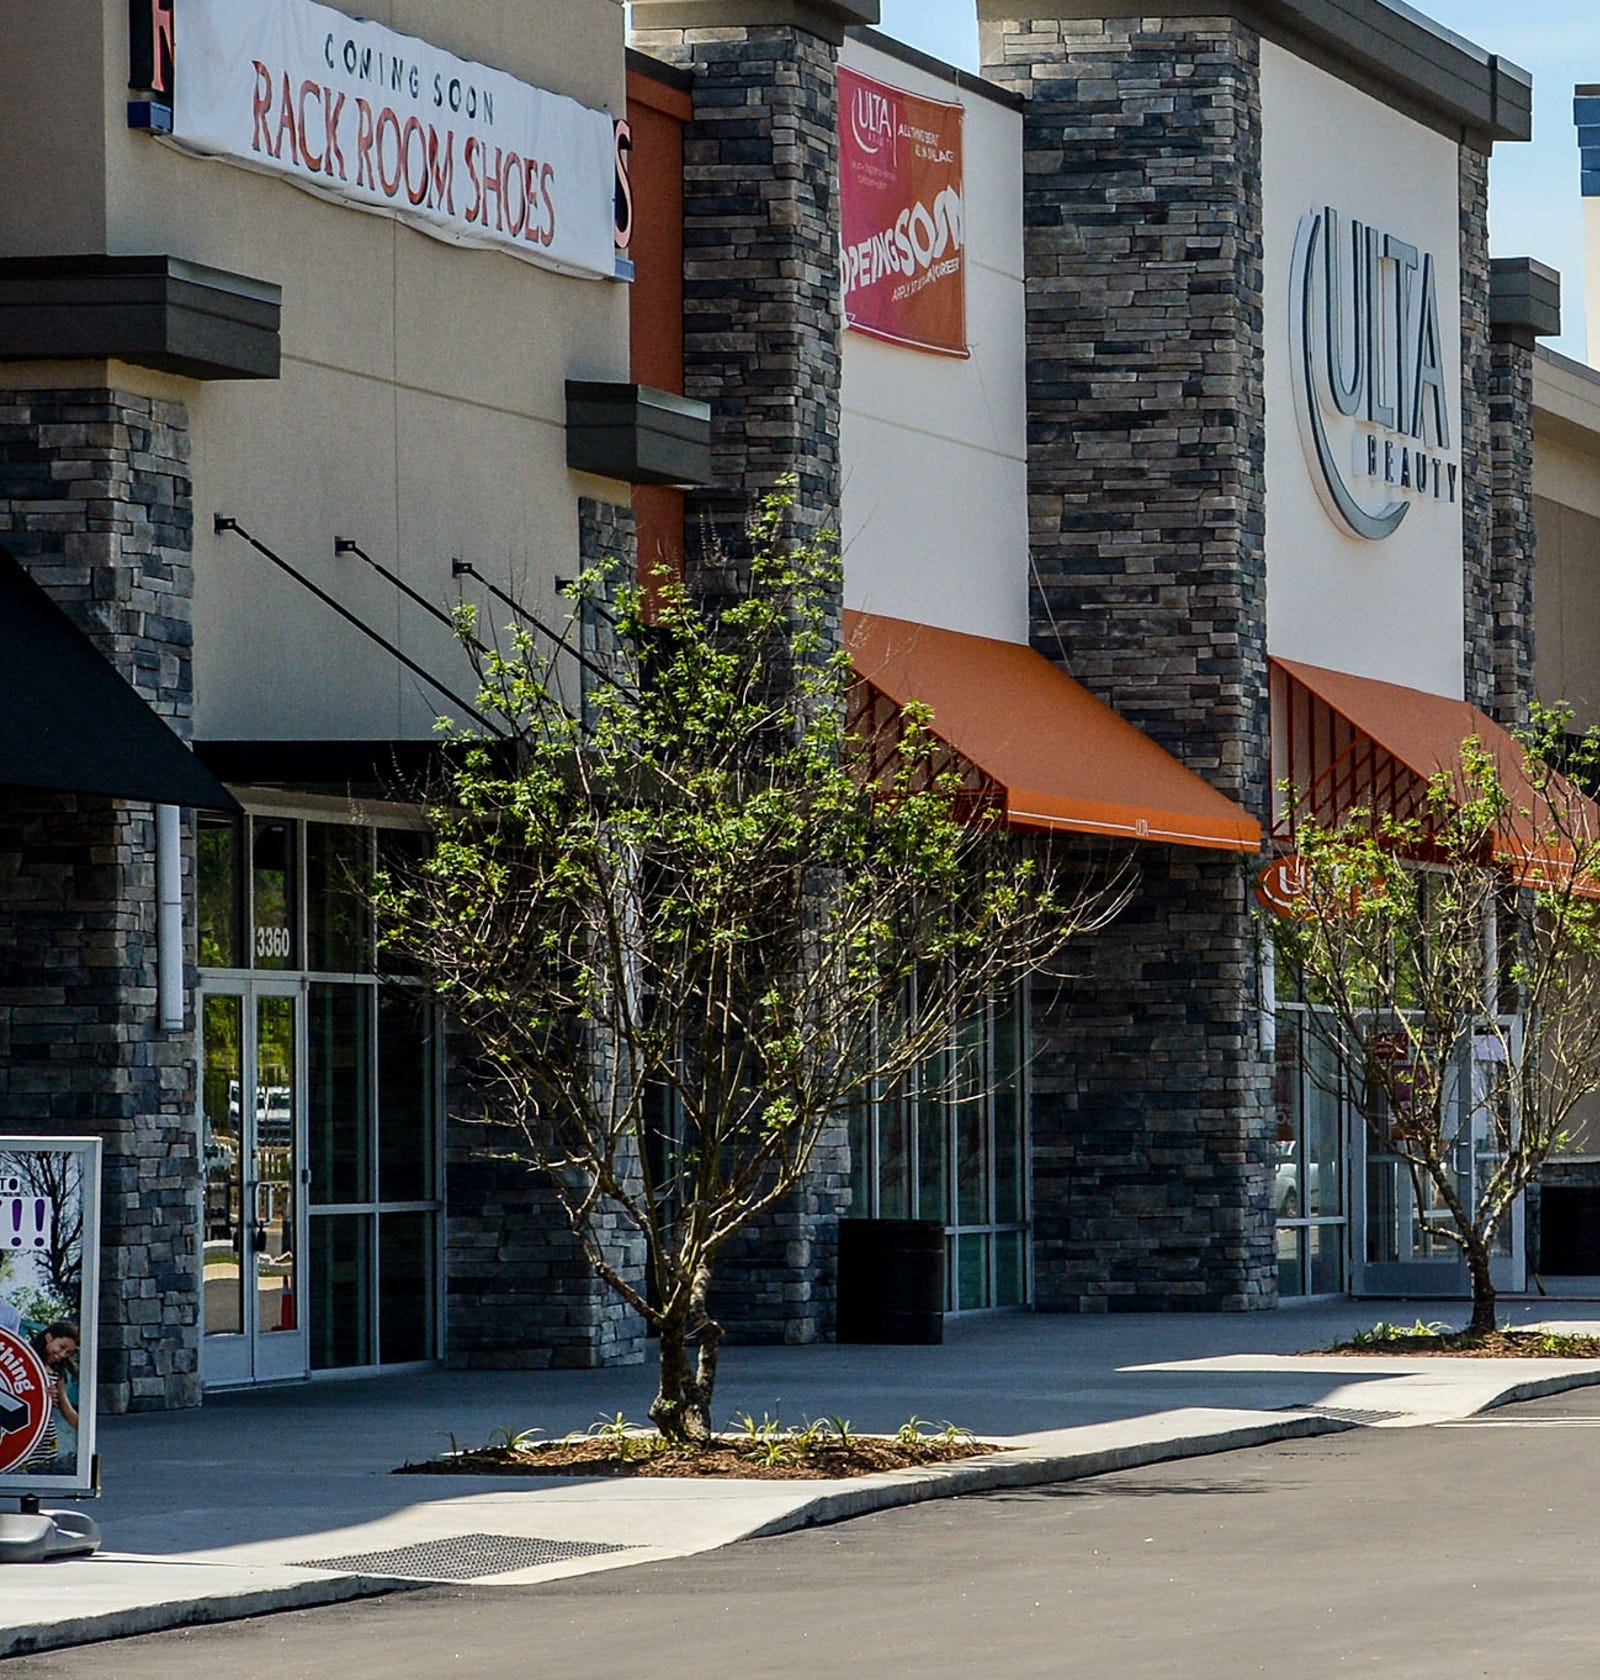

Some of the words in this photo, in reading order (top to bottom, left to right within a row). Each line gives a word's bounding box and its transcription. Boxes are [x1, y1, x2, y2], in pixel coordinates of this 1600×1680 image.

[325, 33, 420, 98] COMING
[433, 73, 493, 125] SOON
[858, 88, 892, 138] ULTA
[252, 60, 347, 181] RACK
[355, 97, 455, 216] ROOM
[464, 136, 555, 247] SHOES
[1325, 206, 1449, 450] ULTA
[1367, 434, 1457, 502] BEAUTY
[256, 926, 290, 957] 3360
